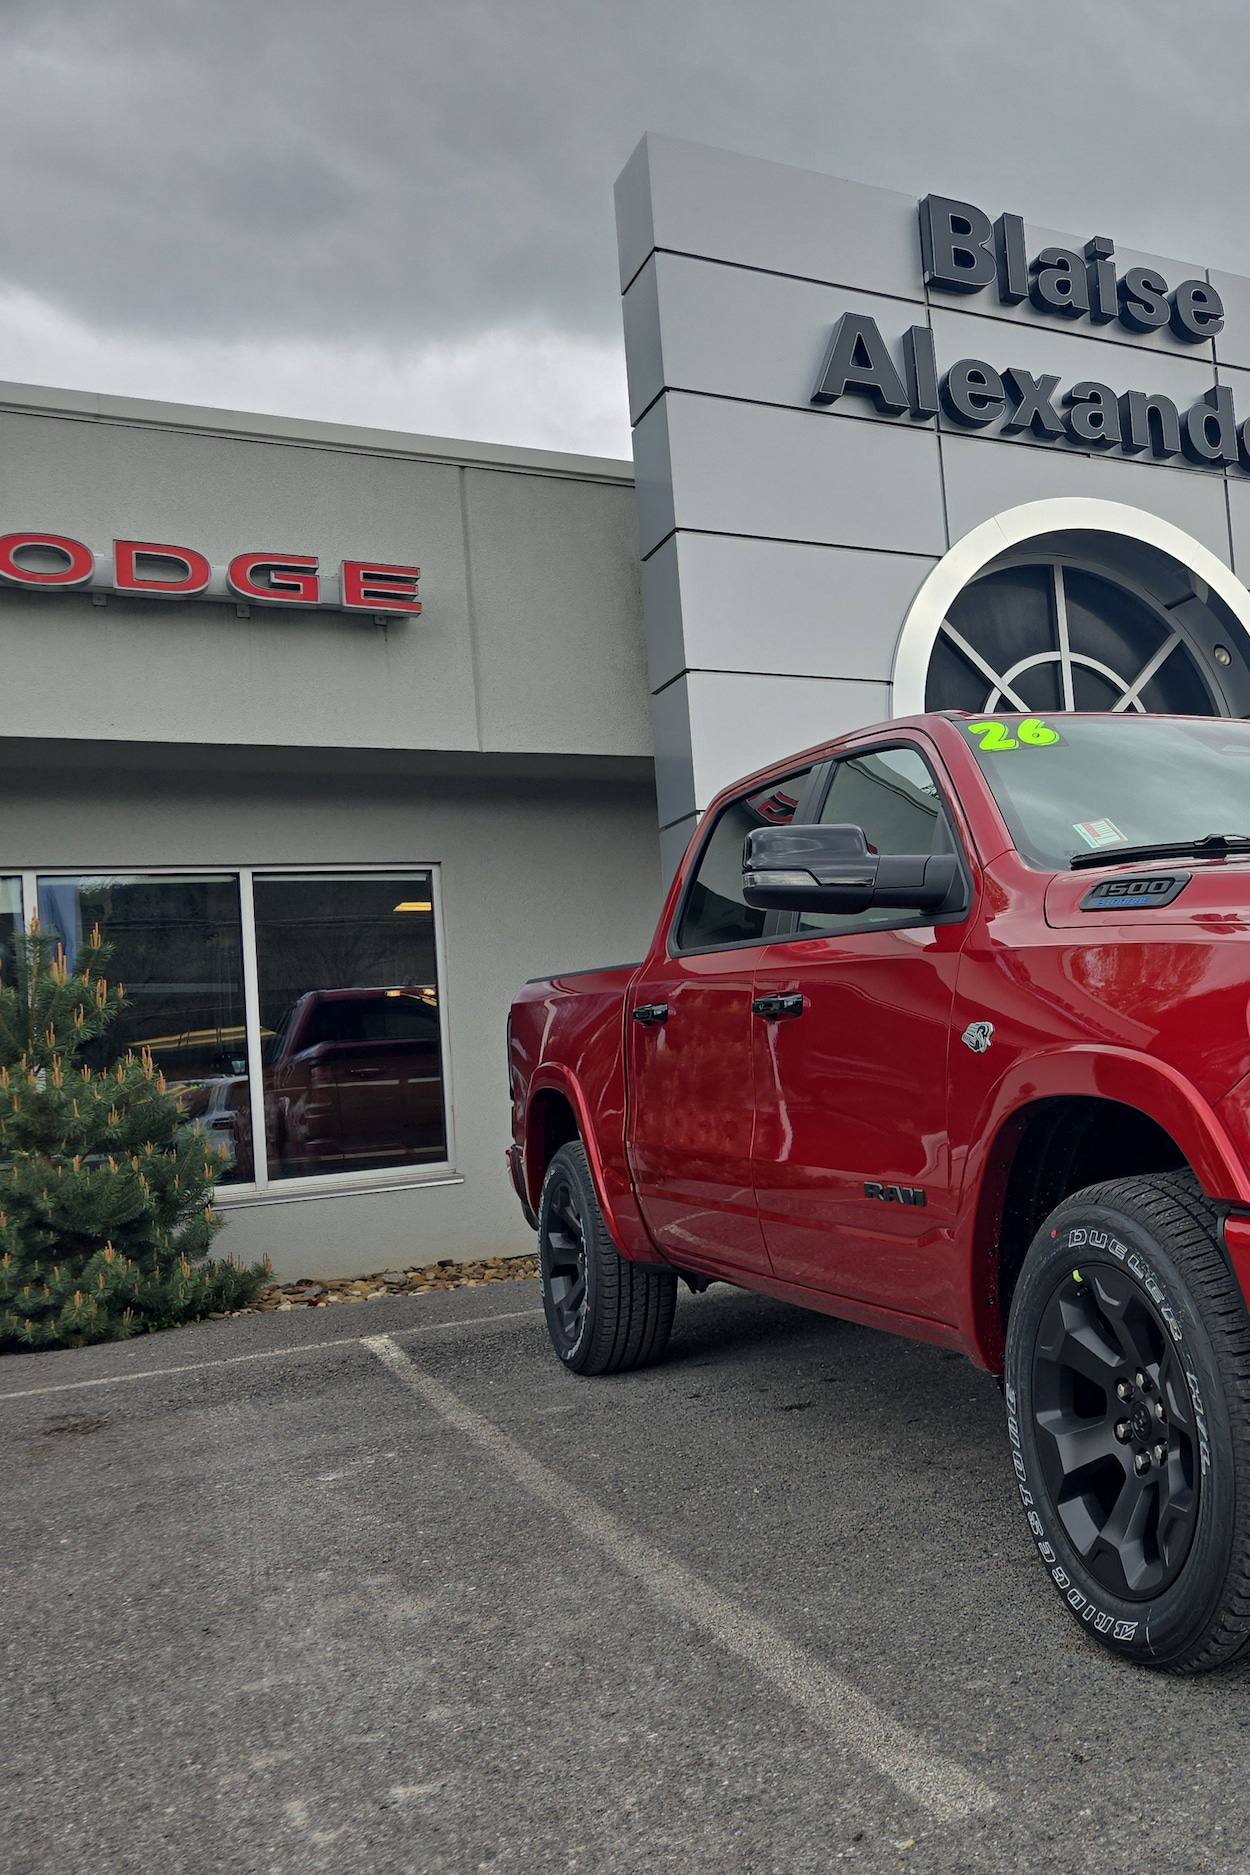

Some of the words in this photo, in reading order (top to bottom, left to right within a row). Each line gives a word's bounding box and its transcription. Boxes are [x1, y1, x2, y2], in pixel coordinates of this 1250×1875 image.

[918, 193, 1225, 344] Blaise
[0, 532, 423, 618] ODGE
[967, 719, 1060, 752] 26
[1099, 880, 1172, 897] 1500
[863, 1181, 927, 1208] RAM
[1068, 1228, 1183, 1342] DUELER
[1005, 1383, 1139, 1641] BRIDGESTONE
